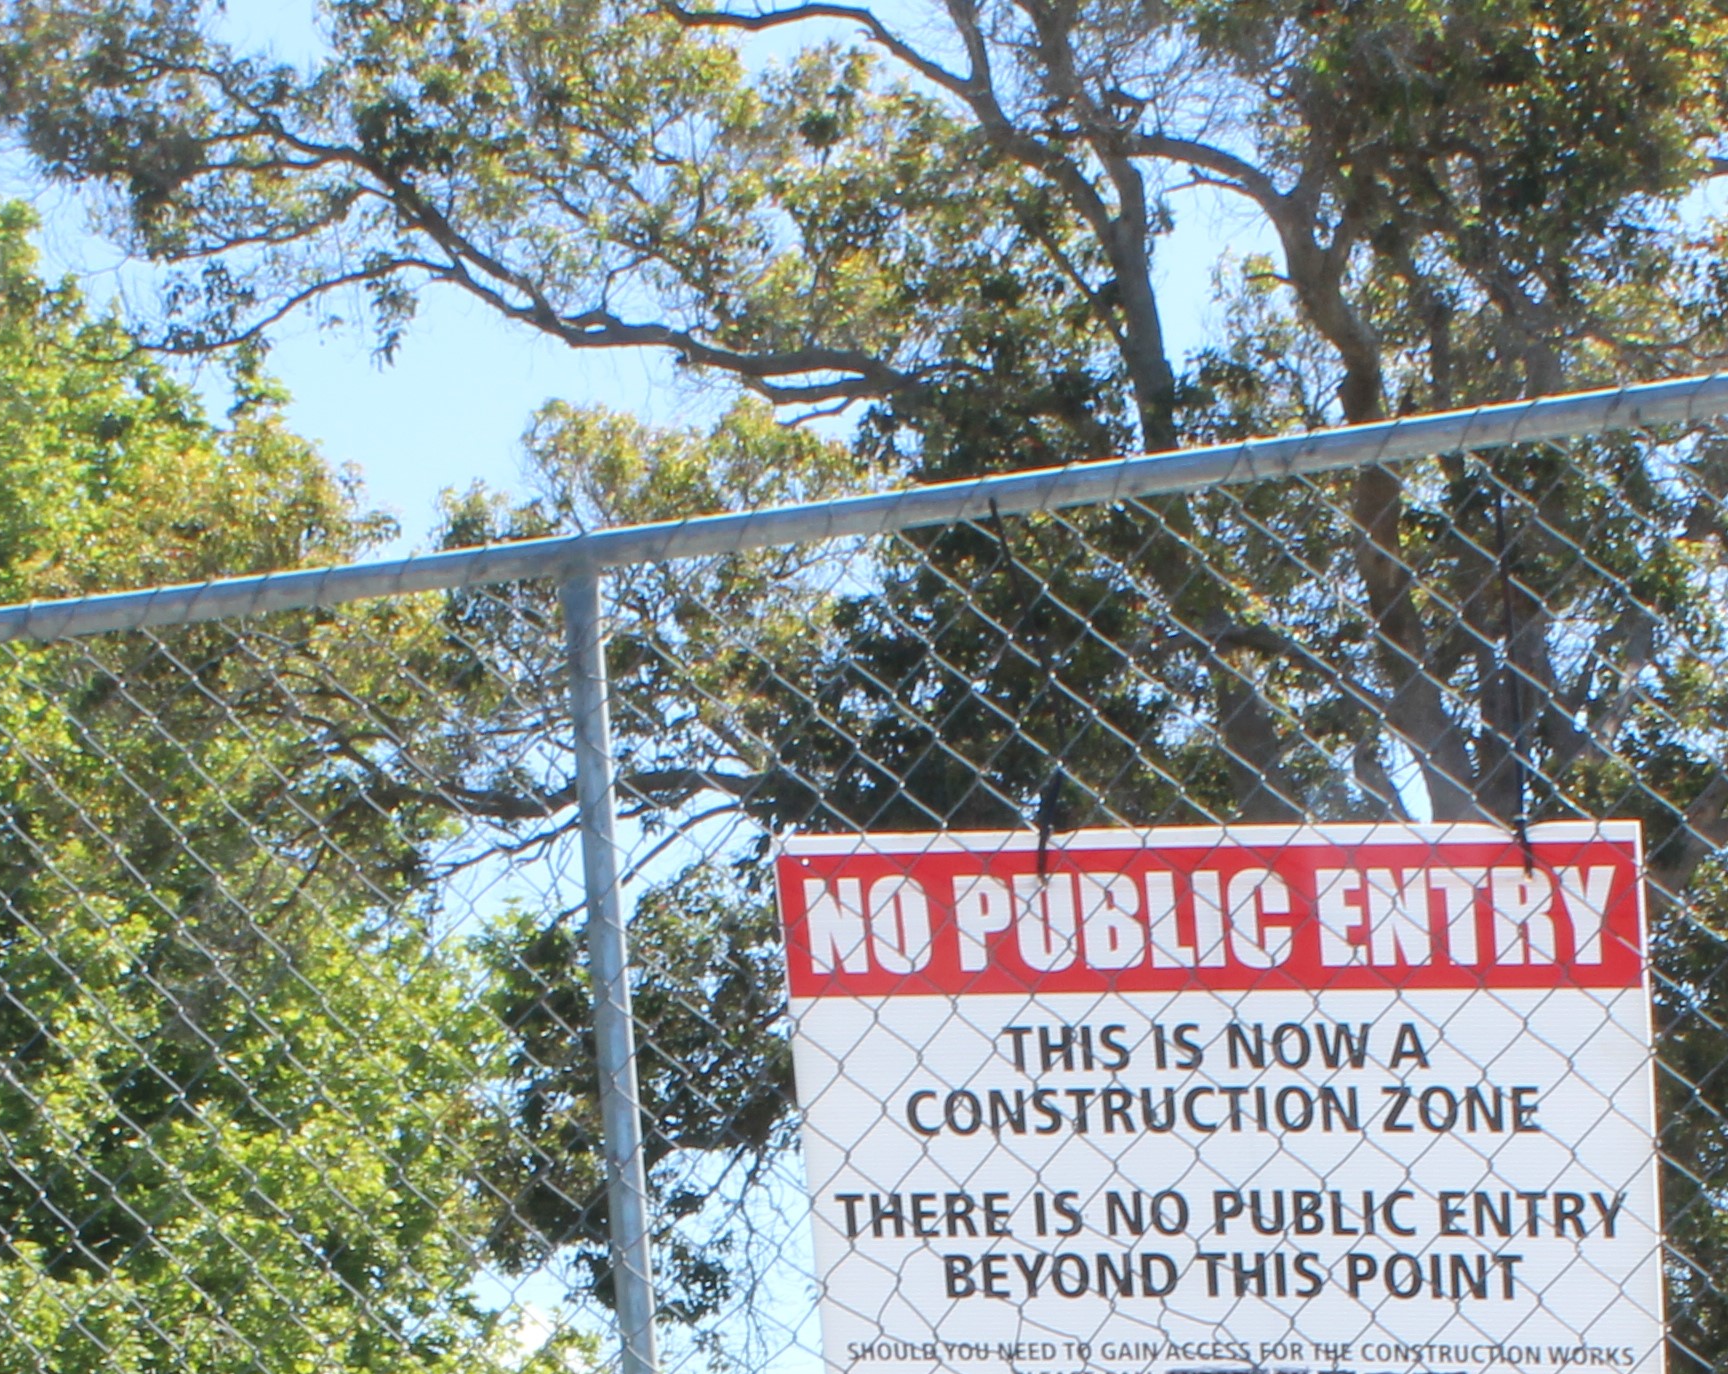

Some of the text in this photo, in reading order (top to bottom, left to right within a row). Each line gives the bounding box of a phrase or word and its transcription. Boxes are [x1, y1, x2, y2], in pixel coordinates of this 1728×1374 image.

[803, 863, 1616, 976] NO PUBLIC ENTRY
[1002, 1021, 1431, 1073] THIS IS NOW A
[907, 1085, 1541, 1137] CONSTRUCTION ZONE
[835, 1189, 1628, 1240] THERE IS NO PUBLIC ENTRY
[944, 1251, 1526, 1301] BEYOND THIS POINT
[847, 1341, 1635, 1367] SHOULD YOU NEED TO GAIN ACCESS FOR THE CONSTRUCTION WORKS
